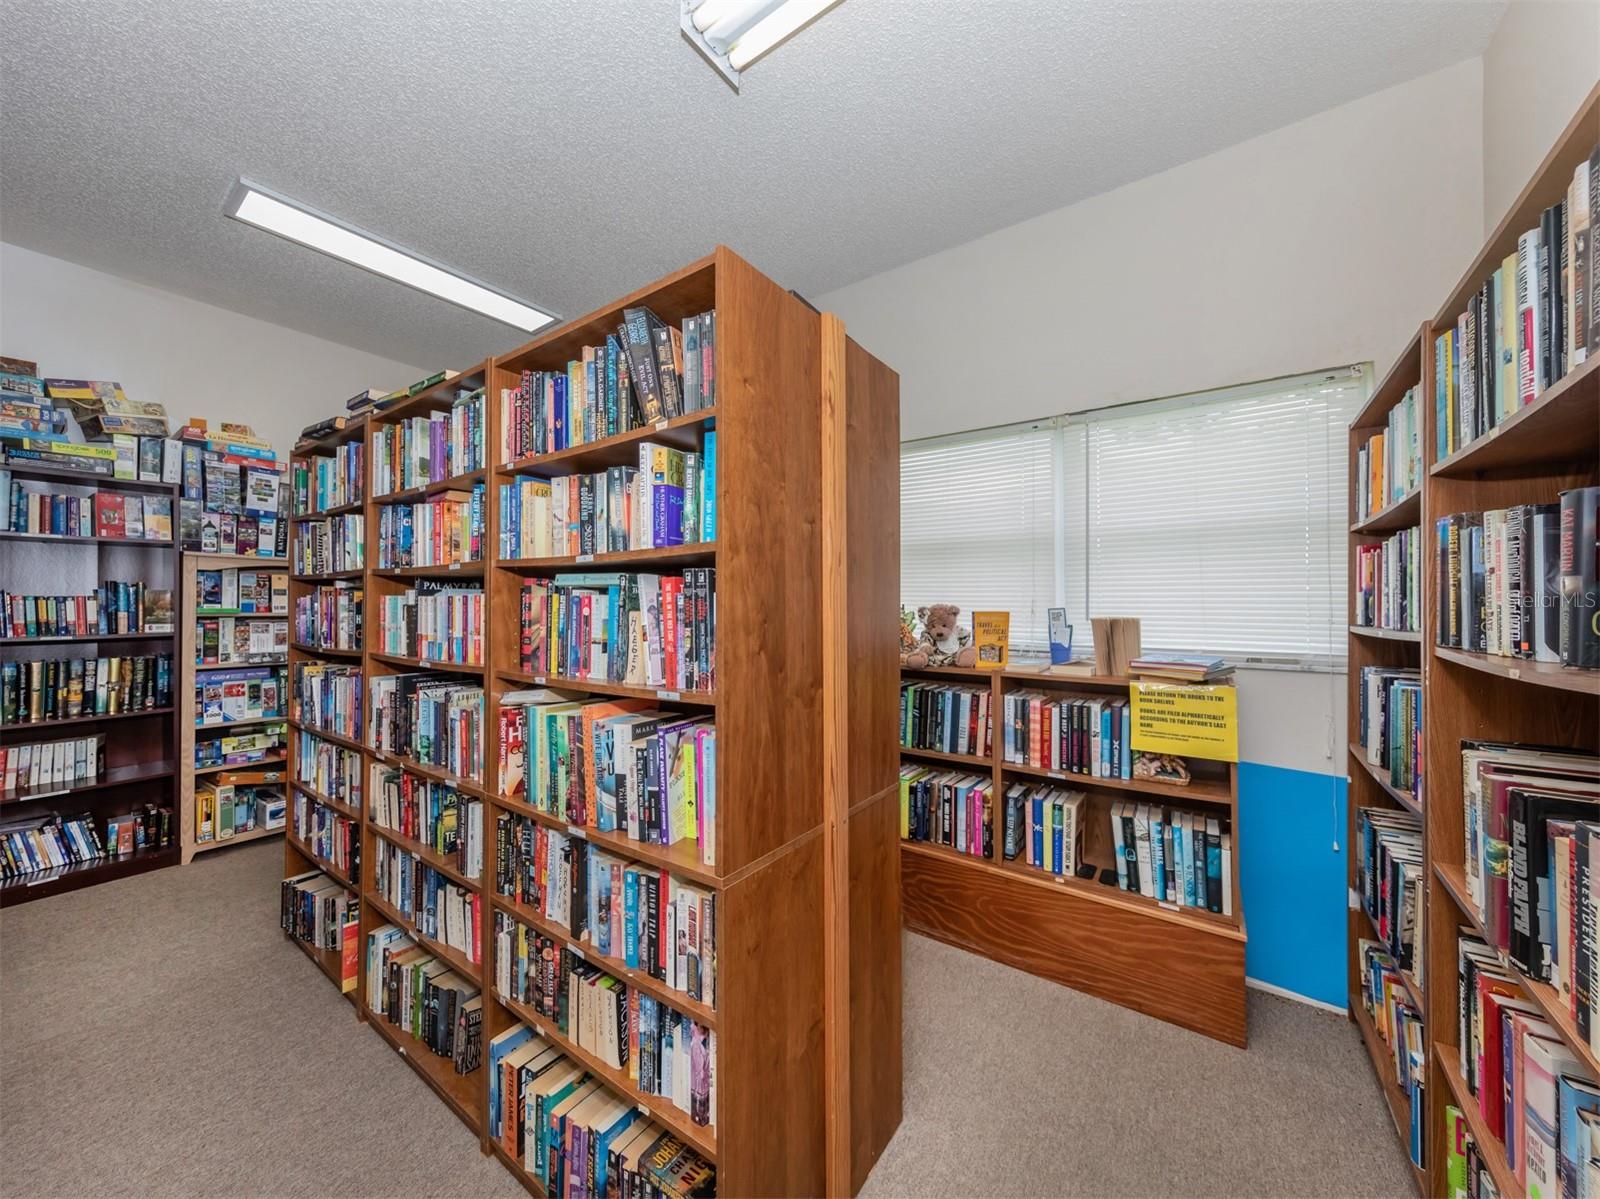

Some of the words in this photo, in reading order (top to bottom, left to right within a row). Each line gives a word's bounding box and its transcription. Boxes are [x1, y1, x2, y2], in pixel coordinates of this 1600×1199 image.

[1519, 238, 1528, 261] PAUL
[1518, 264, 1529, 306] LINDSAY
[628, 322, 640, 344] GEORGE
[636, 316, 648, 345] ELIZABETH
[638, 364, 646, 380] EVIL
[644, 358, 652, 372] JUST
[641, 380, 649, 394] ACT
[1506, 510, 1520, 538] BONNIE
[1562, 508, 1574, 528] KAT
[278, 520, 286, 551] NATIONAL
[1448, 526, 1458, 552] ROBERT
[1560, 531, 1574, 572] MARTIN
[1448, 554, 1458, 584] LUDLUM
[1508, 590, 1520, 606] OUT
[1486, 612, 1495, 632] DAYS
[1509, 615, 1520, 642] ORDER
[1181, 712, 1224, 720] ALPHABETICALLY
[1187, 719, 1212, 728] AUTHOR'S
[635, 726, 654, 734] MARK
[1512, 819, 1529, 880] BLIND
[1513, 880, 1530, 936] FAITH
[1582, 866, 1591, 956] PRESIDENT
[1590, 903, 1598, 944] Terry
[1590, 947, 1598, 1015] McMillan
[620, 993, 628, 1062] JACKSON
